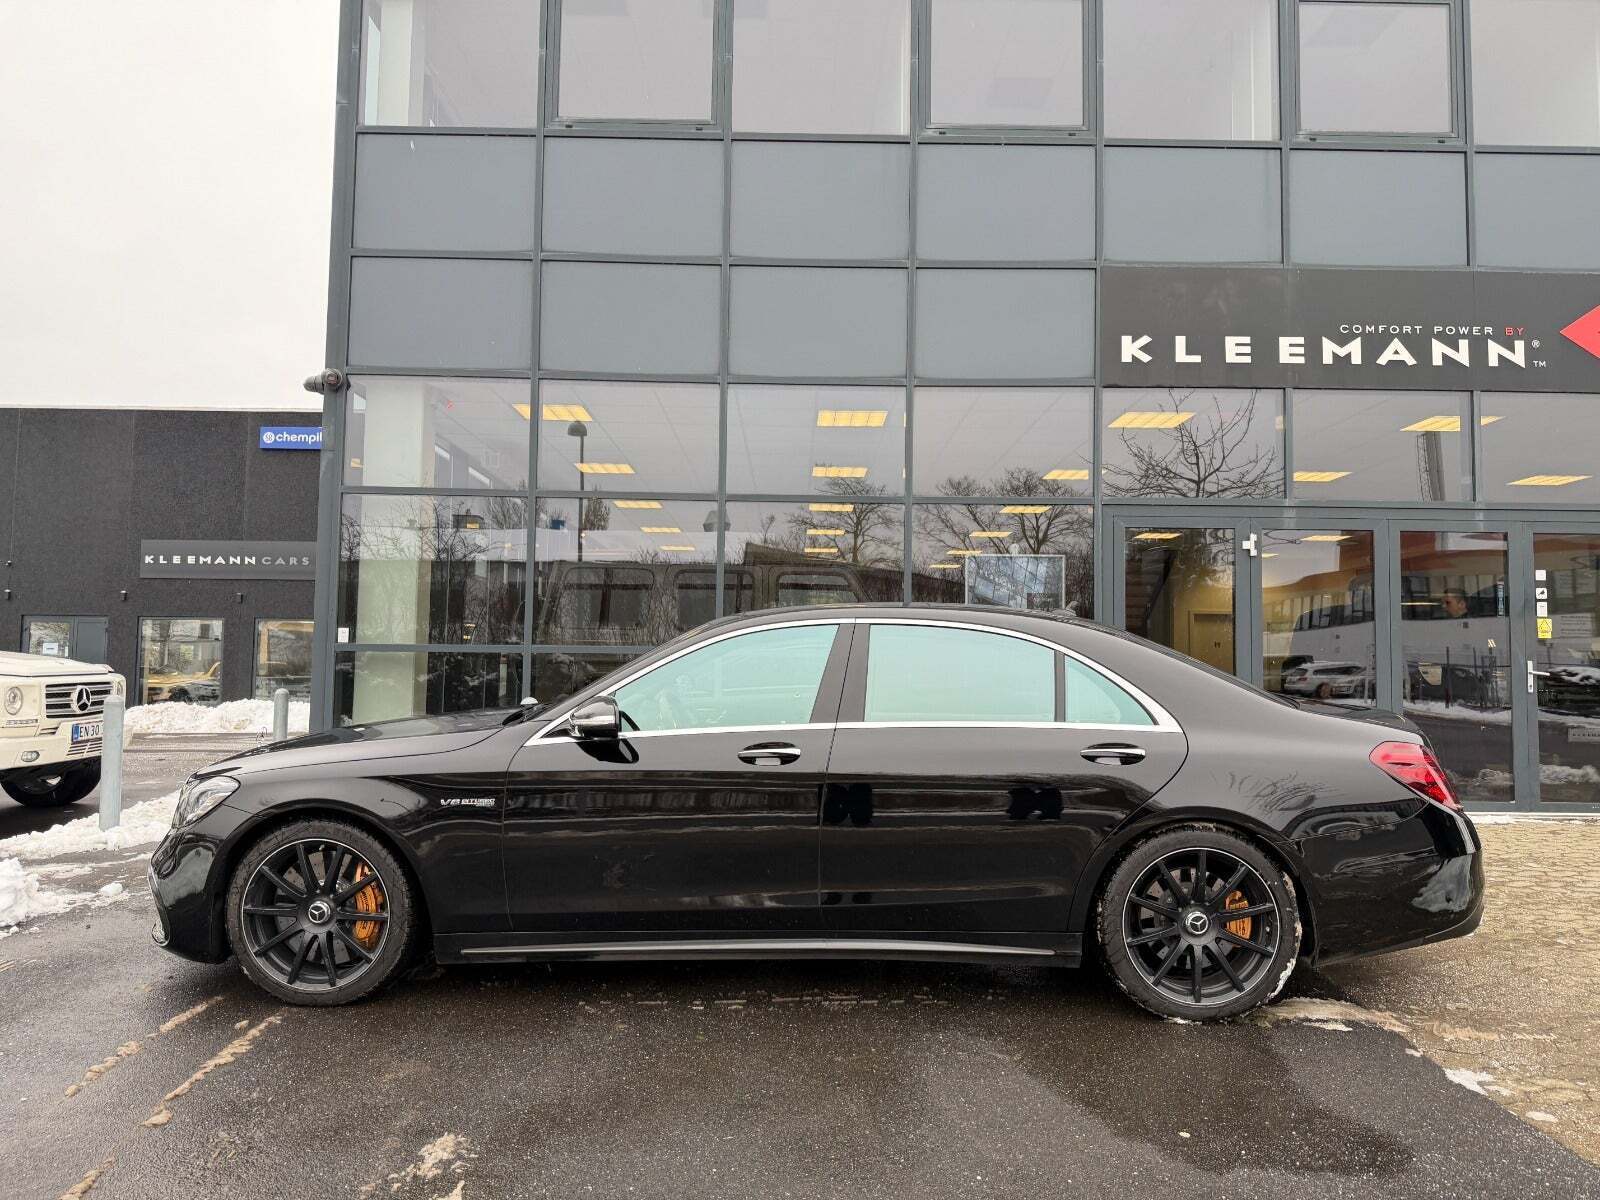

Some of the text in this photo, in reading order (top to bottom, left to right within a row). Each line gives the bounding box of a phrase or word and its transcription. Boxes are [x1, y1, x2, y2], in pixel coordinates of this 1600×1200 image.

[1340, 324, 1525, 336] COMFORT POWER BY
[1121, 335, 1526, 369] KLEEMANN
[144, 555, 310, 566] KLEEMANN CARS
